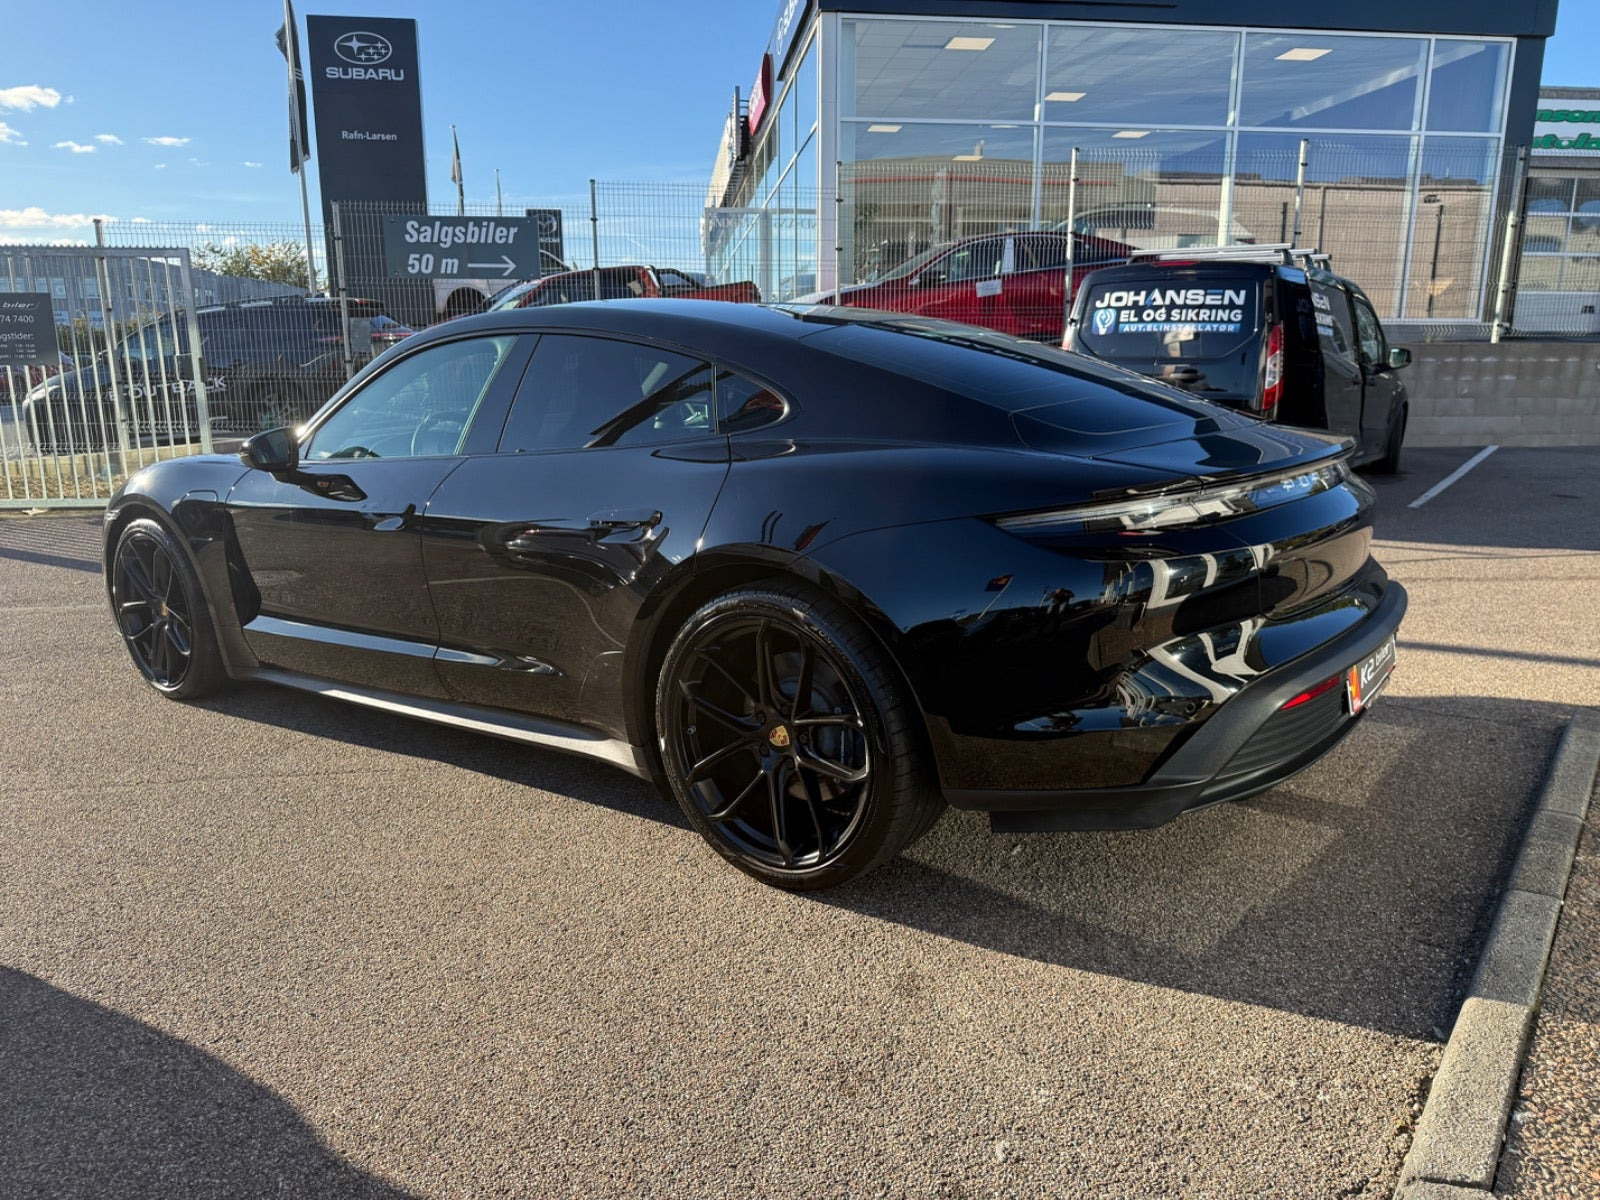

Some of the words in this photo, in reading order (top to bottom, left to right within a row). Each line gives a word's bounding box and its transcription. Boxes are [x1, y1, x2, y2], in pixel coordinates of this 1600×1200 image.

[325, 66, 405, 81] SUBARU
[341, 130, 398, 141] Rafn-Larsen
[404, 220, 518, 248] Salgsbiler
[407, 253, 434, 274] 50
[440, 257, 459, 275] m
[1095, 288, 1247, 308] JOHANSEN
[13, 314, 34, 323] 7400
[1119, 310, 1139, 322] EL
[1142, 308, 1167, 321] OG
[1170, 308, 1243, 322] SIKRING
[0, 331, 34, 342] gstider:
[1361, 658, 1375, 689] K2
